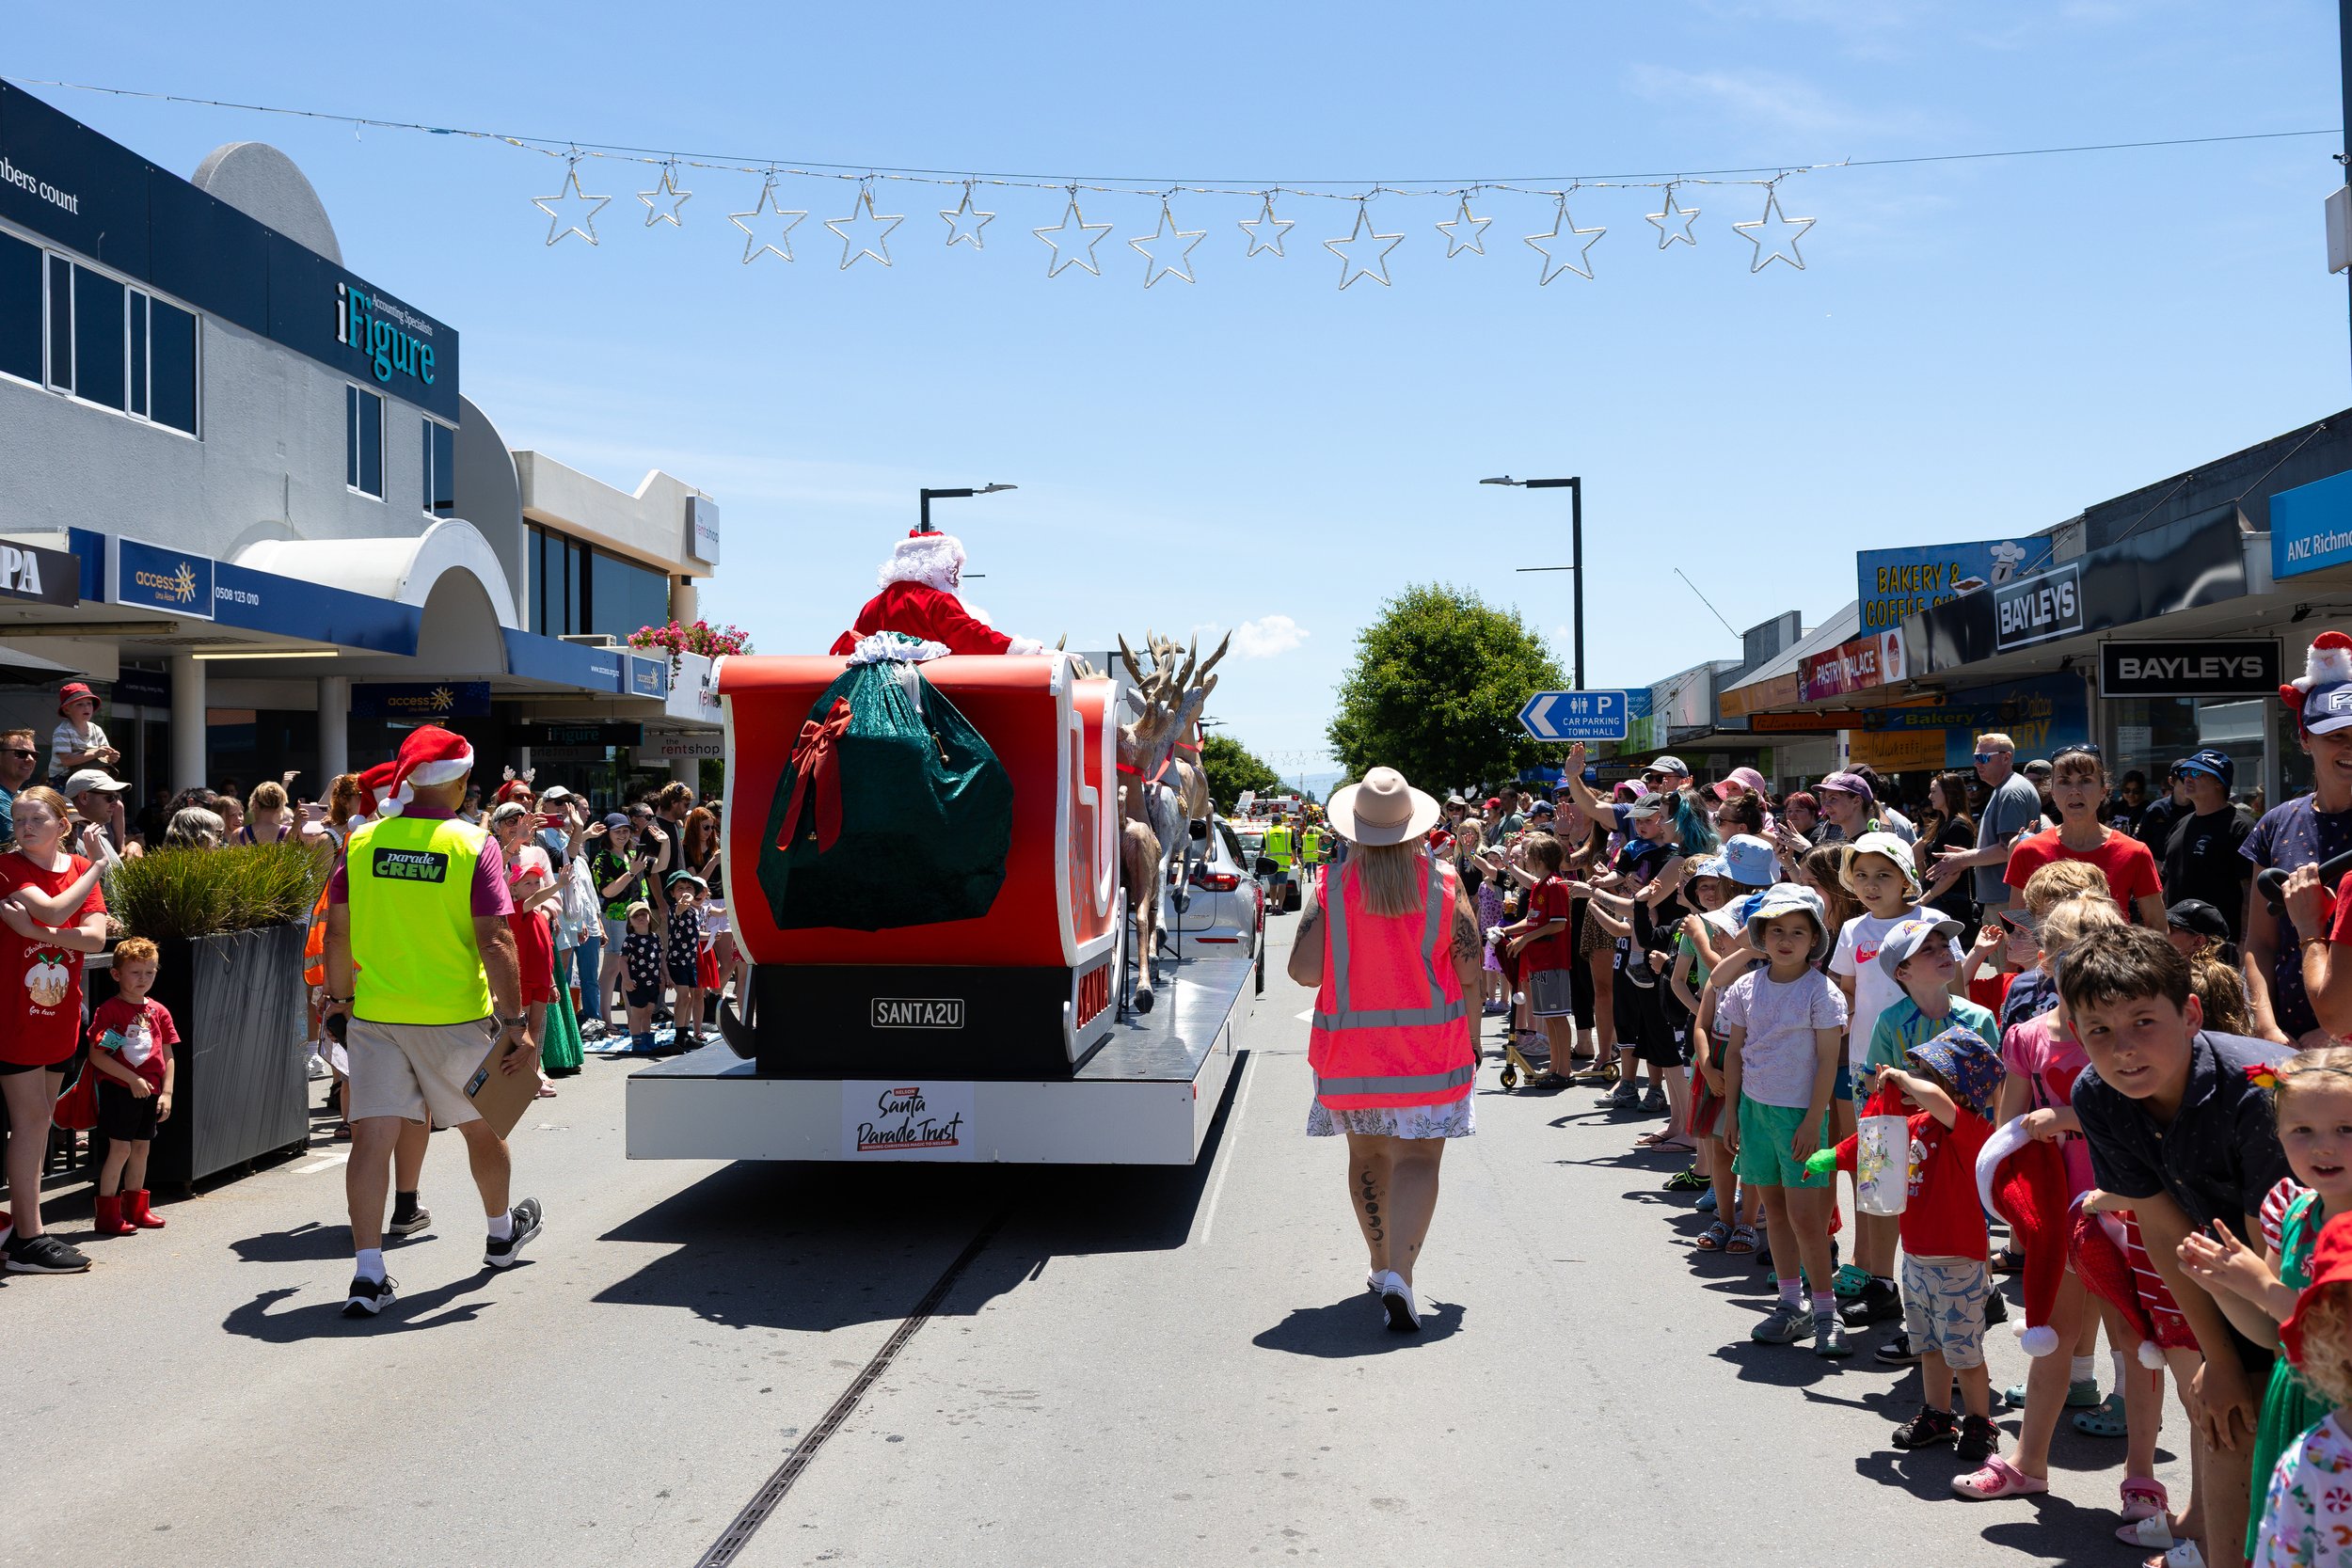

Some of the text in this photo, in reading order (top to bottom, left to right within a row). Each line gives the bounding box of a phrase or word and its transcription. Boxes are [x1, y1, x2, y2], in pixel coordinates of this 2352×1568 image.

[40, 182, 79, 215] count
[372, 293, 433, 337] Accounting Specialists
[336, 282, 436, 385] iFigure
[696, 524, 720, 545] rentshop
[2287, 536, 2312, 562] ANZ
[135, 570, 175, 592] access
[1877, 562, 1961, 594] BAKERY &
[215, 586, 260, 607] 0508 123 010
[1999, 579, 2075, 636] BAYLEYS
[1816, 658, 1843, 687] PASTRY
[1844, 649, 1876, 681] PALACE
[2119, 657, 2265, 680] BAYLEYS
[388, 696, 430, 706] access
[1597, 696, 1613, 715] P
[1563, 717, 1620, 726] CAR PARKING
[1905, 710, 1977, 726] Bakery
[548, 727, 600, 745] iFigure
[1567, 728, 1615, 736] TOWN HALL
[661, 743, 720, 756] rentshop
[387, 852, 435, 865] parade
[376, 860, 443, 879] CREW
[29, 1006, 56, 1017] for two
[877, 1002, 959, 1025] SANTA2U
[878, 1087, 926, 1119] Santa
[857, 1112, 964, 1151] Parade Trust
